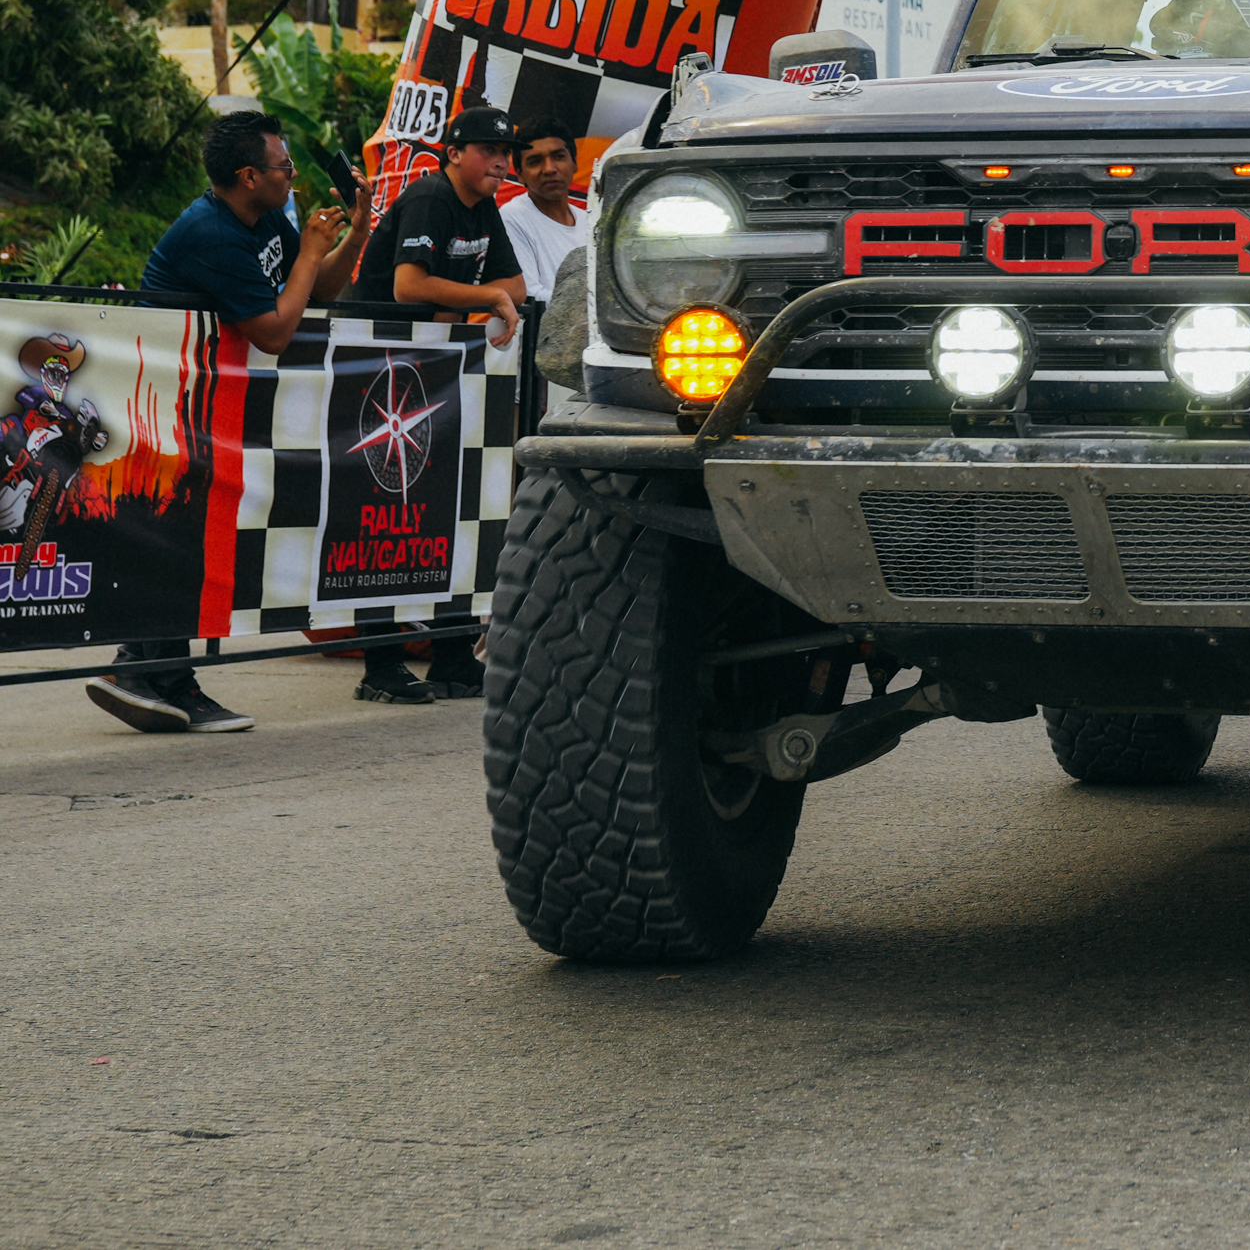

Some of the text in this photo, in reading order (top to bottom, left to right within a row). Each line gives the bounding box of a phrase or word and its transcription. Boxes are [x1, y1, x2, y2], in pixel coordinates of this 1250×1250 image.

[843, 6, 933, 41] RESTAANT
[782, 61, 846, 86] AMSOIL
[1050, 74, 1240, 95] Ford
[386, 84, 447, 139] 2025
[360, 503, 426, 537] RALLY
[327, 537, 449, 573] NAVIGATOR
[324, 570, 448, 589] RALLY ROADBOOK SYSTEM
[20, 602, 86, 618] TRAINING
